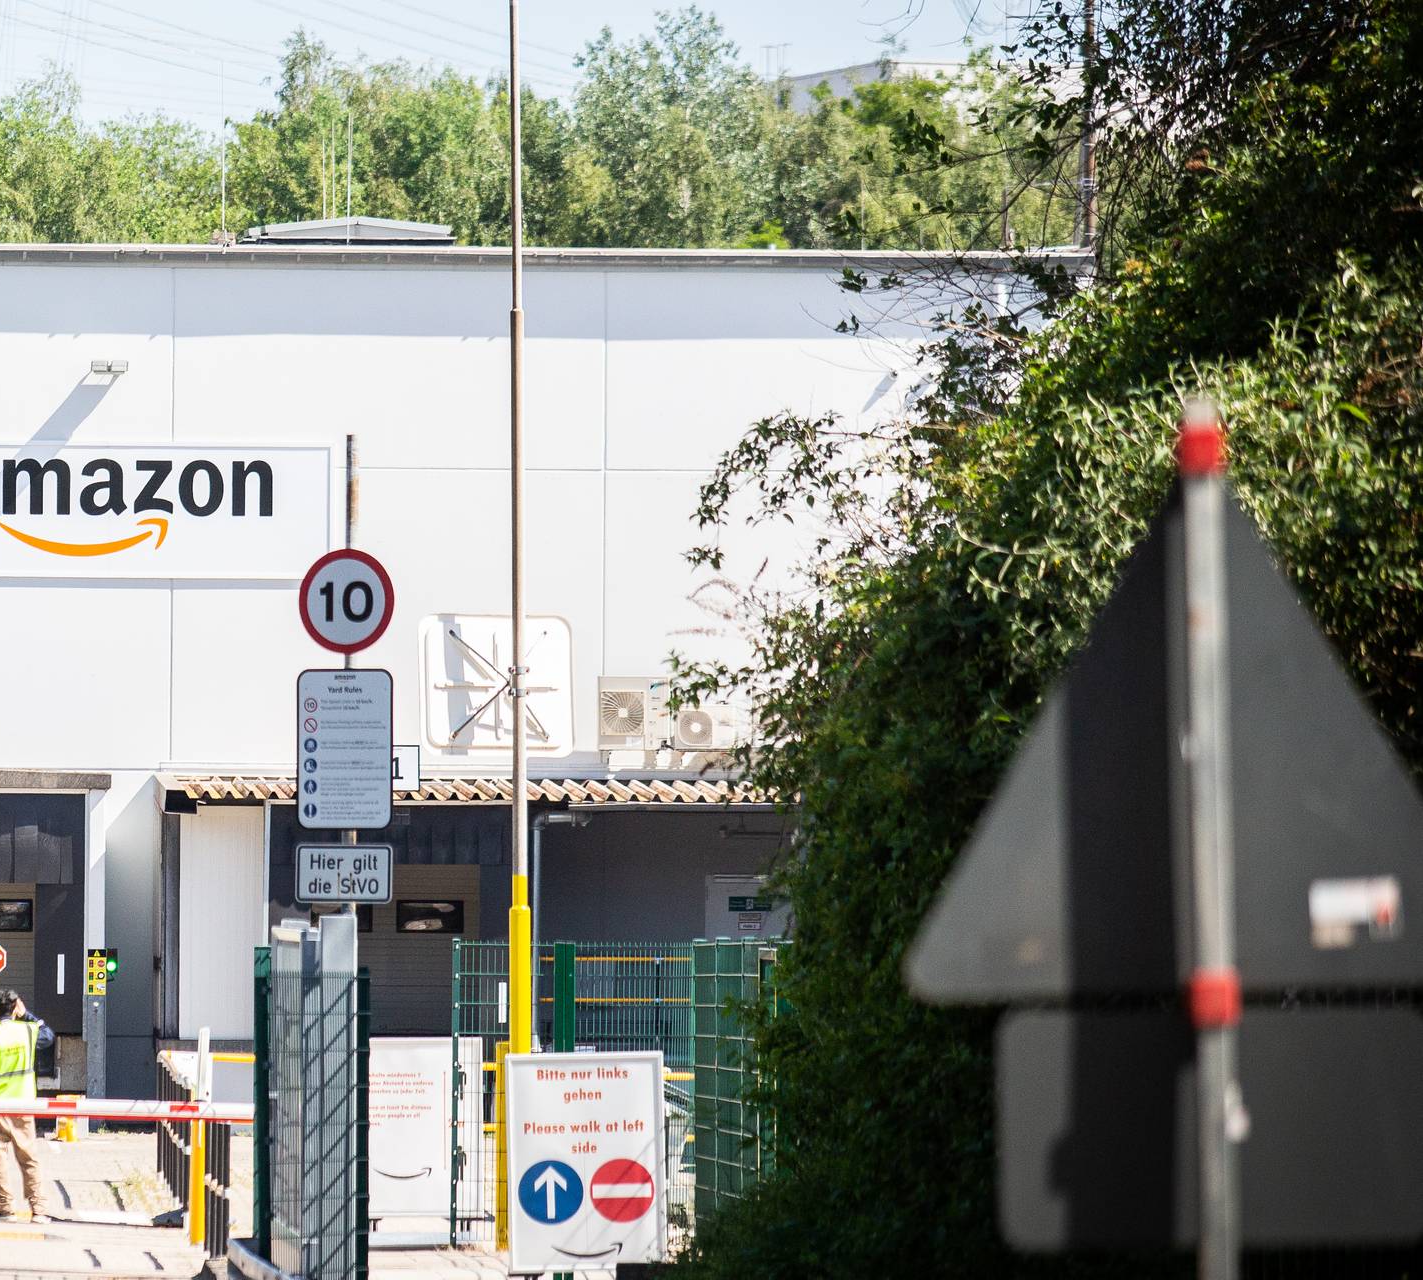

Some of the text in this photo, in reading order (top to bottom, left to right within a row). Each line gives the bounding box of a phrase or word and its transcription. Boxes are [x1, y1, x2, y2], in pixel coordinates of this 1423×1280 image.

[319, 581, 374, 623] 10
[328, 686, 363, 694] Yard Rules
[392, 757, 404, 780] 1
[310, 854, 378, 875] Hier gilt
[308, 878, 379, 895] die StVO
[536, 1067, 629, 1080] Bitte nur links
[563, 1089, 602, 1104] gehen
[523, 1120, 644, 1135] Please walk at left
[571, 1142, 597, 1154] side
